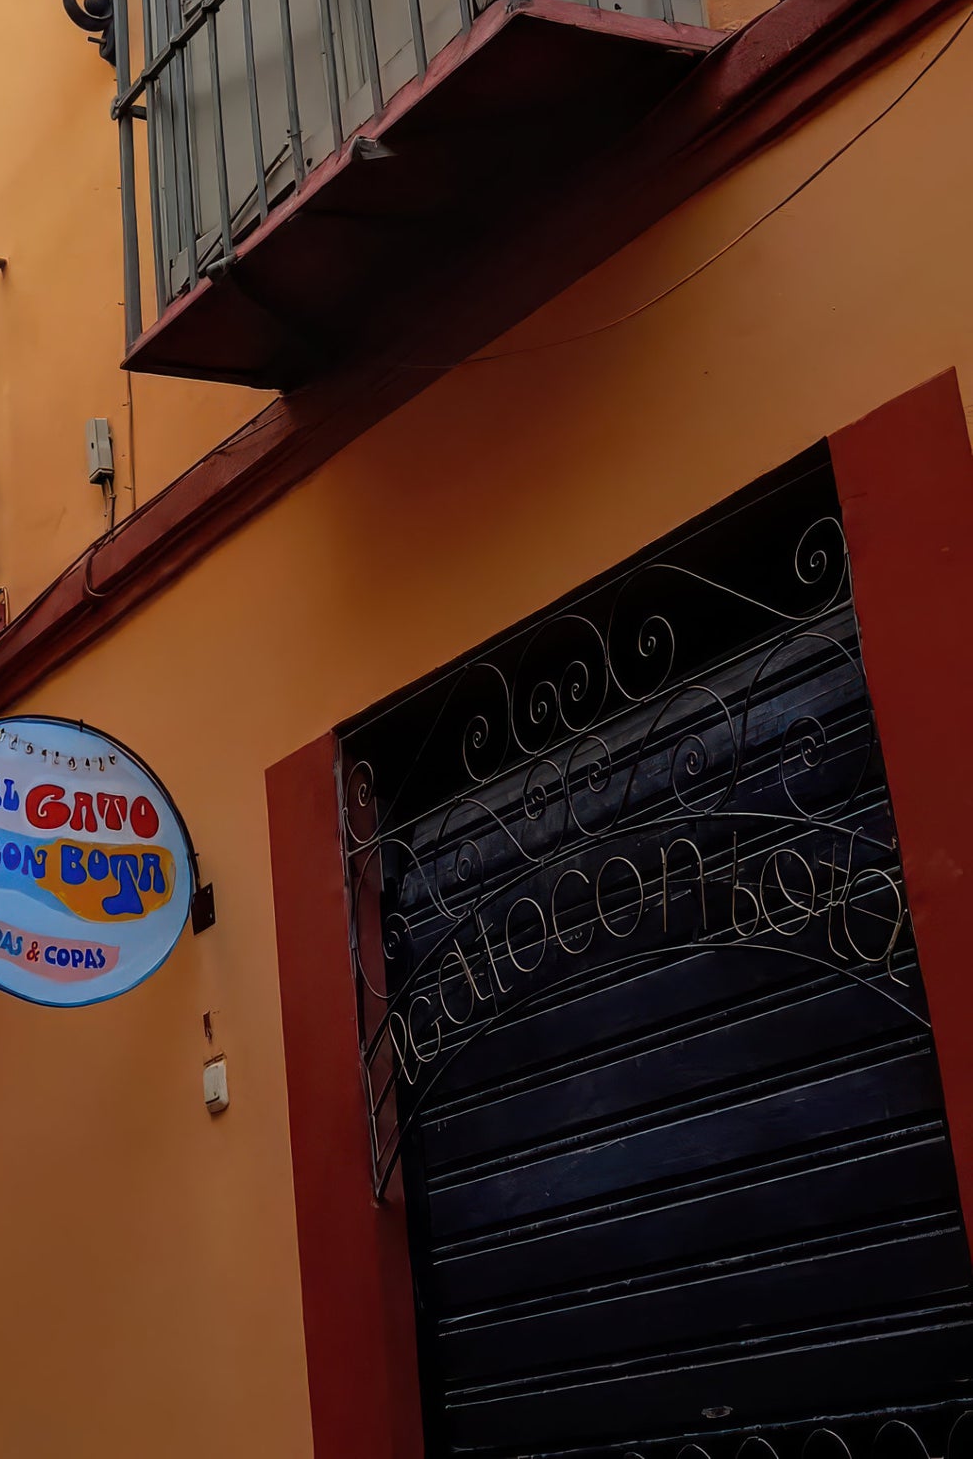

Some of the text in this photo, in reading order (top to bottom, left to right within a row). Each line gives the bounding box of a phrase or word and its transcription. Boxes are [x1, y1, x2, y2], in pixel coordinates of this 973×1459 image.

[25, 783, 160, 839] GATO
[59, 843, 166, 915] BOTA
[26, 941, 40, 961] &
[44, 945, 106, 969] COPAS
